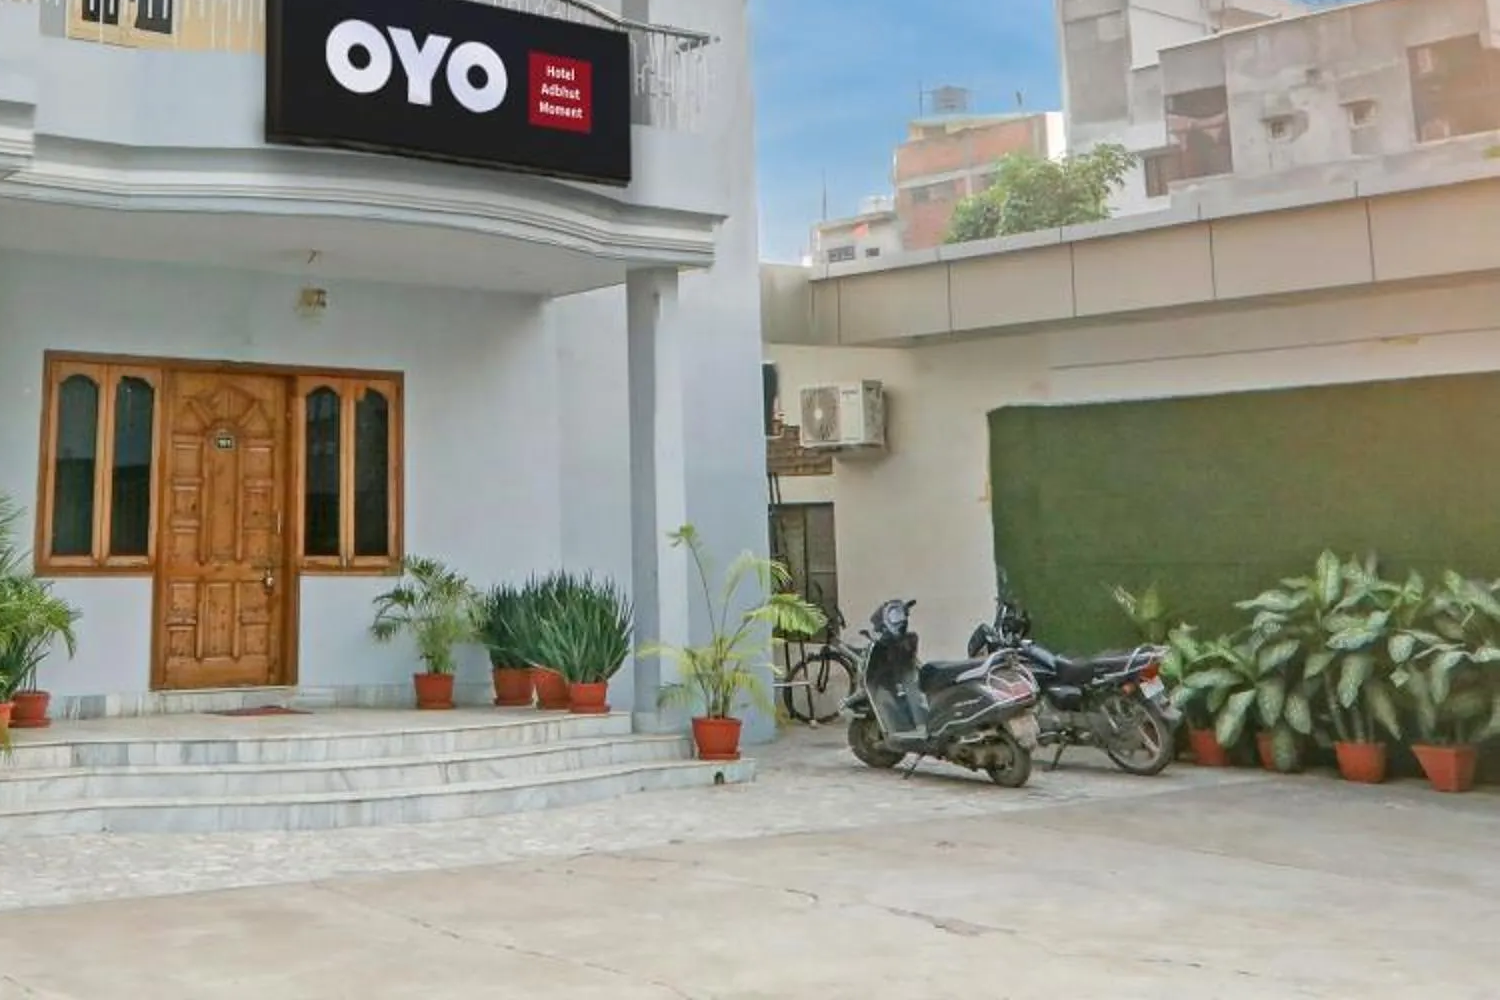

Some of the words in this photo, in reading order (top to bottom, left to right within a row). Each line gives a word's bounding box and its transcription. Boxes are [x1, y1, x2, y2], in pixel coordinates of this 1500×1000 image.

[325, 18, 508, 113] OYO
[546, 65, 575, 81] Hotel
[539, 101, 583, 119] Moment
